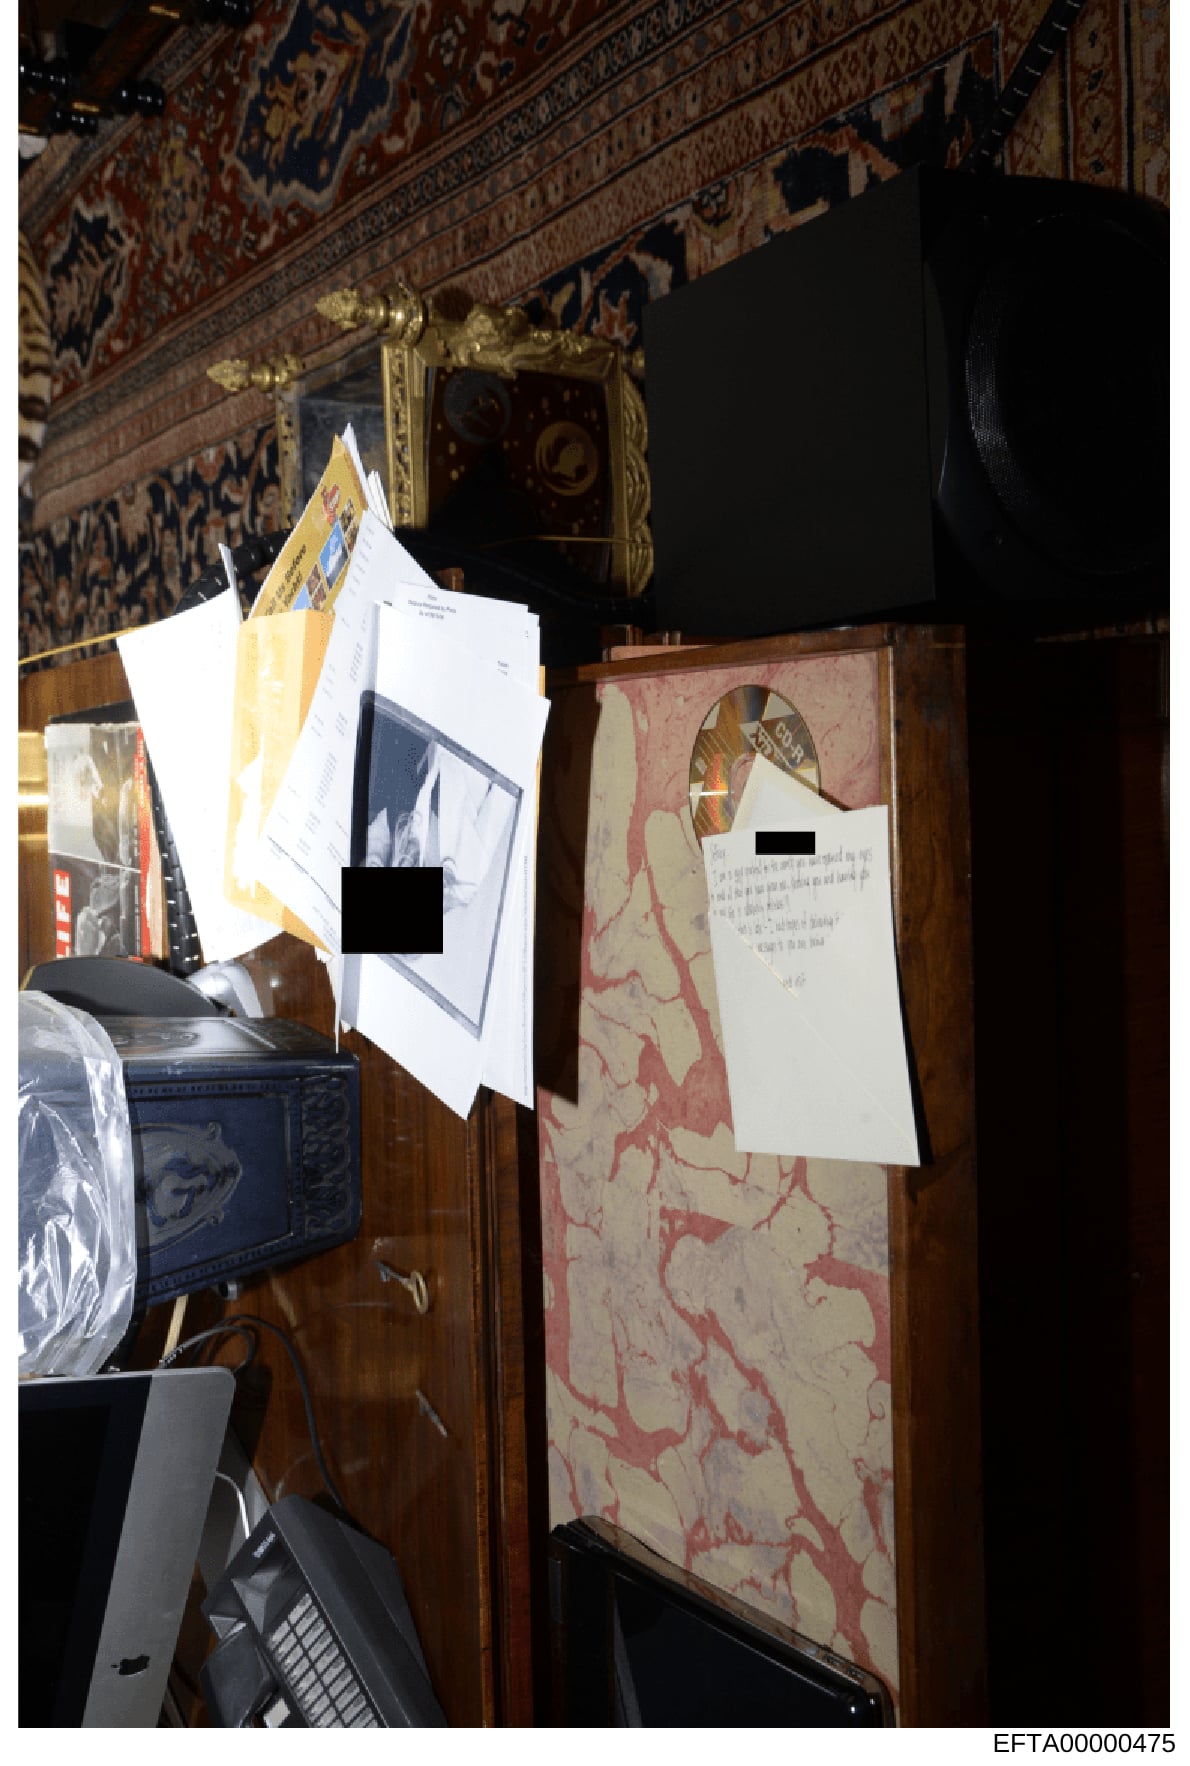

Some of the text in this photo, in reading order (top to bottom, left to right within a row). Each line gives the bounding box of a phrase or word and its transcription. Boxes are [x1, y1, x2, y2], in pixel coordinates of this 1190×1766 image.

[285, 544, 307, 583] Before
[776, 721, 805, 763] CD-R
[56, 873, 70, 958] LIFE
